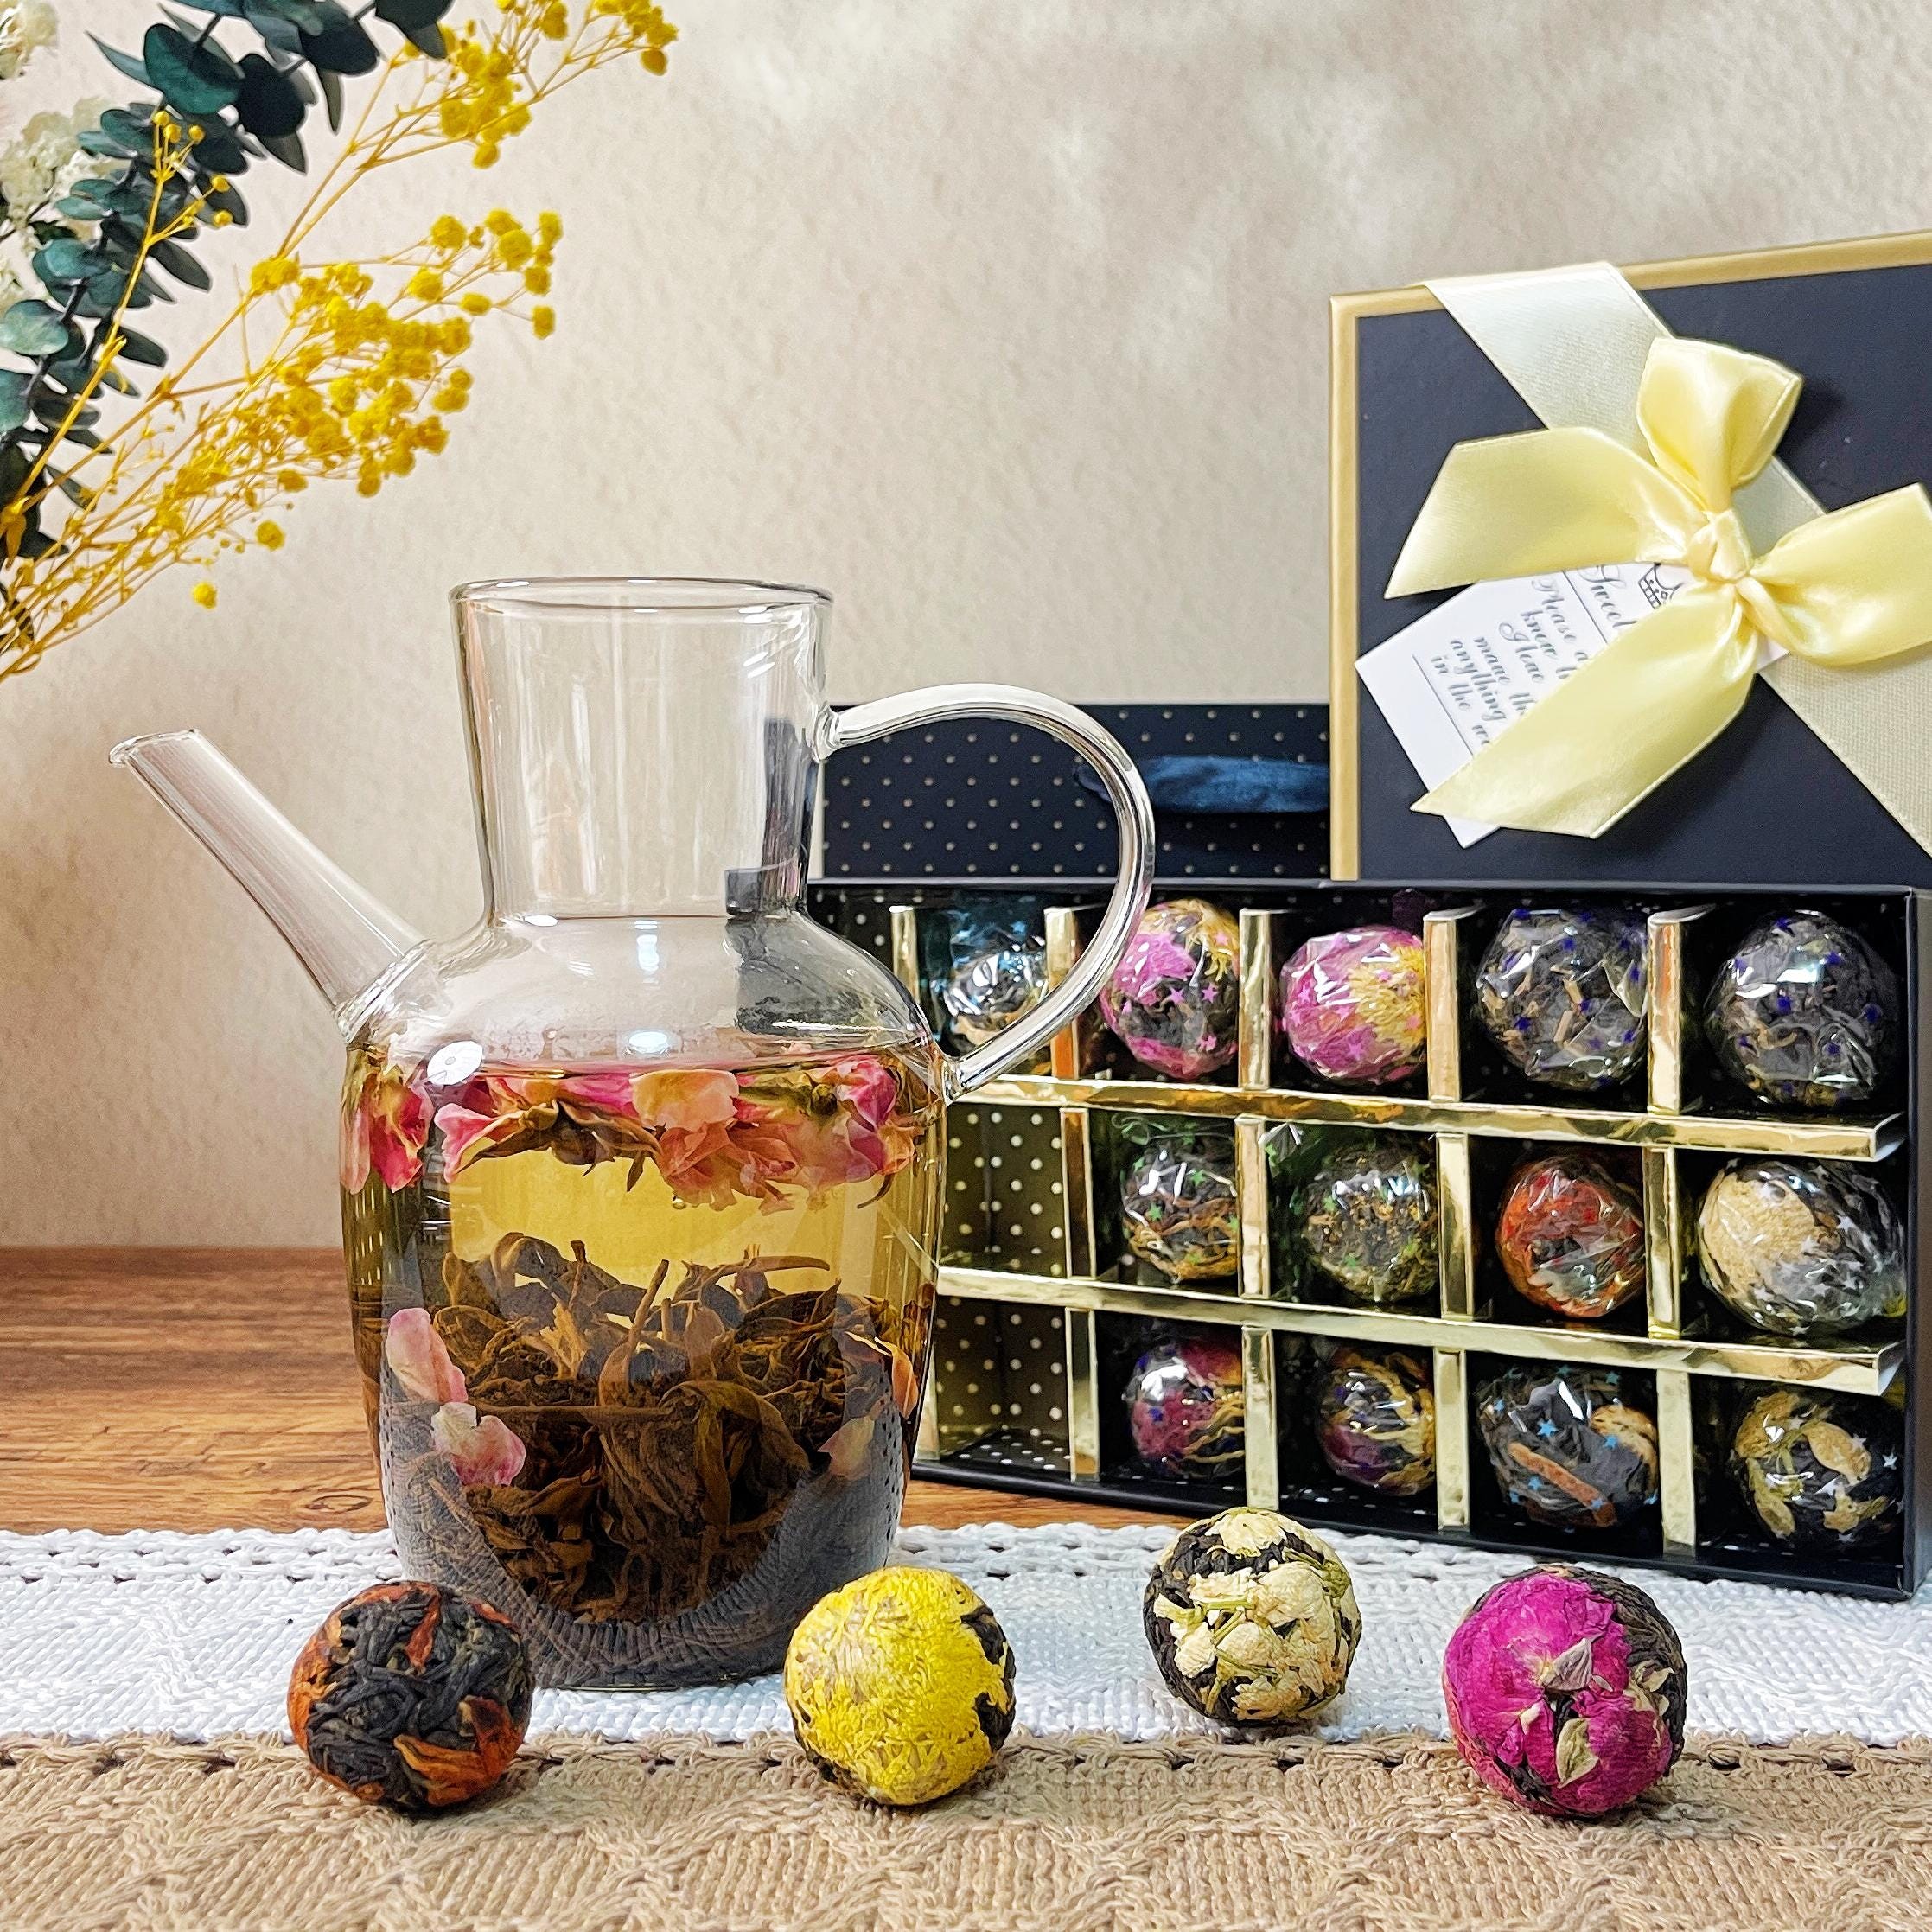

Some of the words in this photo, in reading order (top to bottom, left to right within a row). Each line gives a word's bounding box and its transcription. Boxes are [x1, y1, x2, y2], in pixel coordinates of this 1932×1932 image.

[1520, 610, 1559, 660] know
[1531, 577, 1577, 643] Please
[1431, 655, 1449, 674] in
[1448, 684, 1474, 711] the
[1450, 640, 1508, 722] anything
[1515, 646, 1545, 683] love
